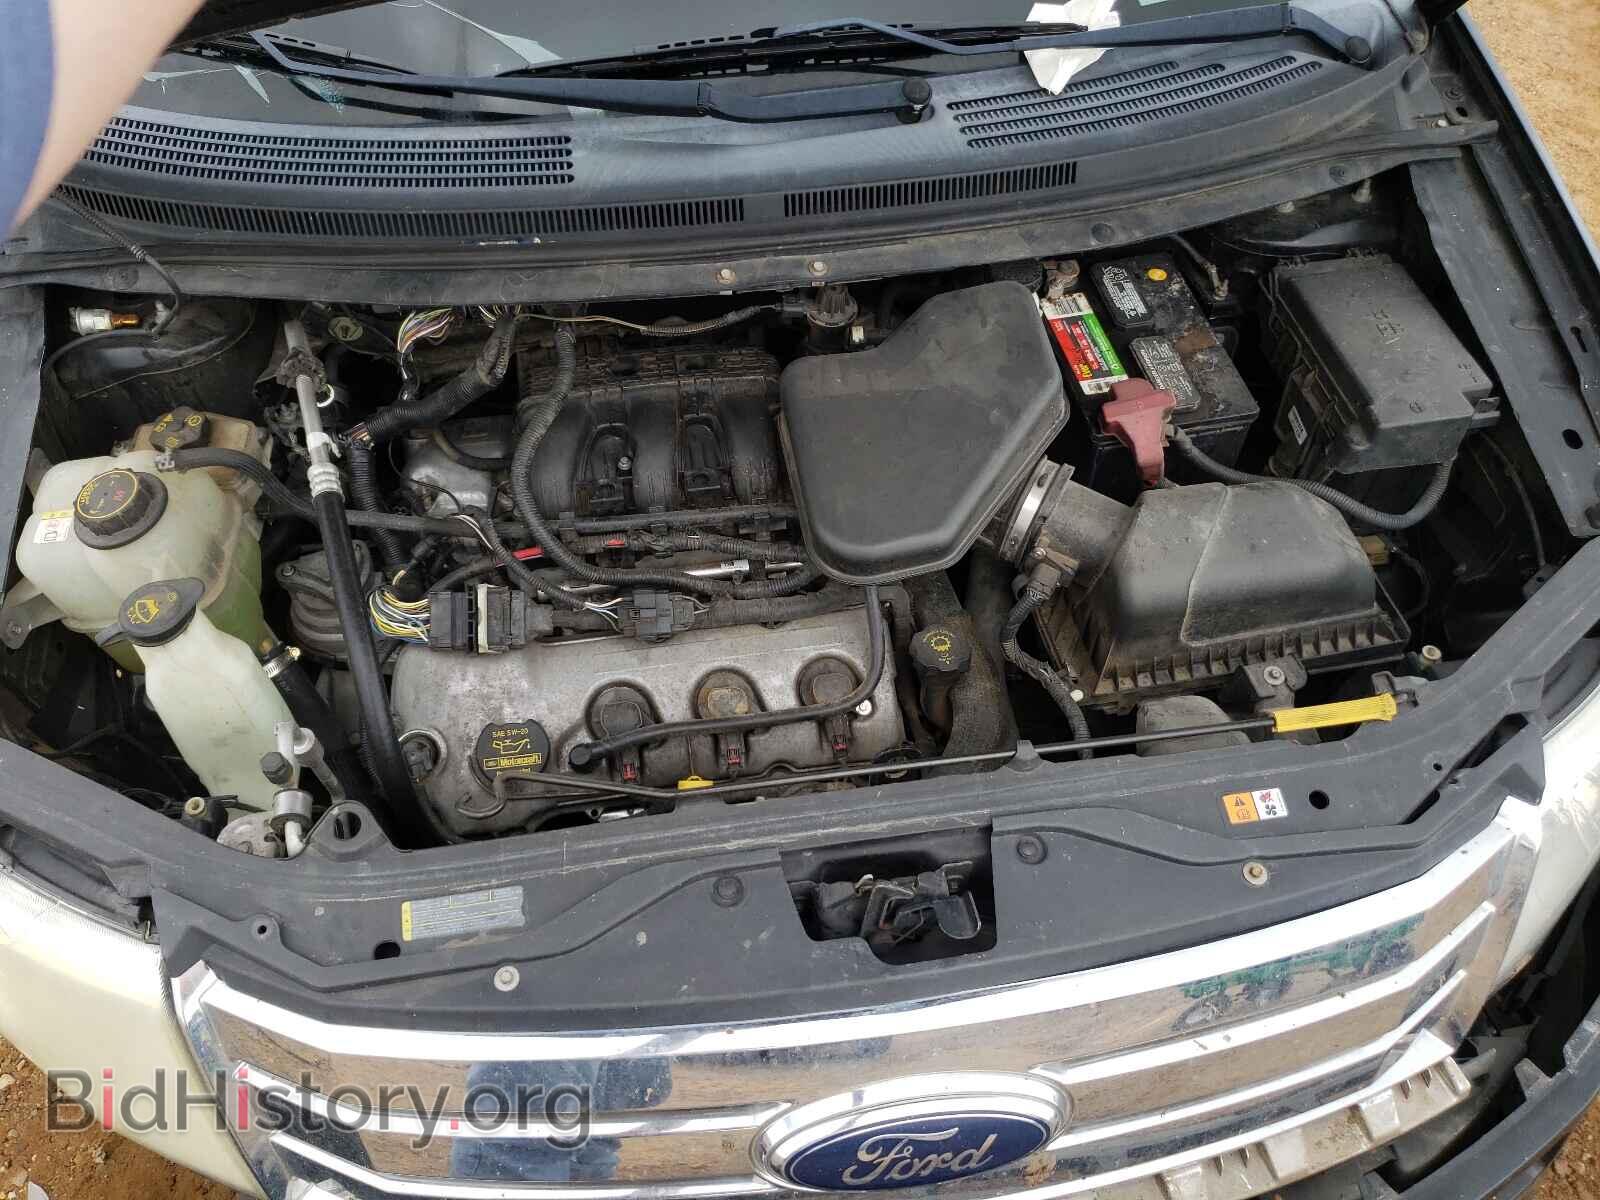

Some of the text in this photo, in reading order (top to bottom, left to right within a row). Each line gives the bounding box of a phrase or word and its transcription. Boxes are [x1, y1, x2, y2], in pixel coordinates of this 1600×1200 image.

[491, 727, 529, 738] SAE 5W-20
[500, 754, 539, 767] Motorcraft
[842, 1127, 999, 1186] Ford
